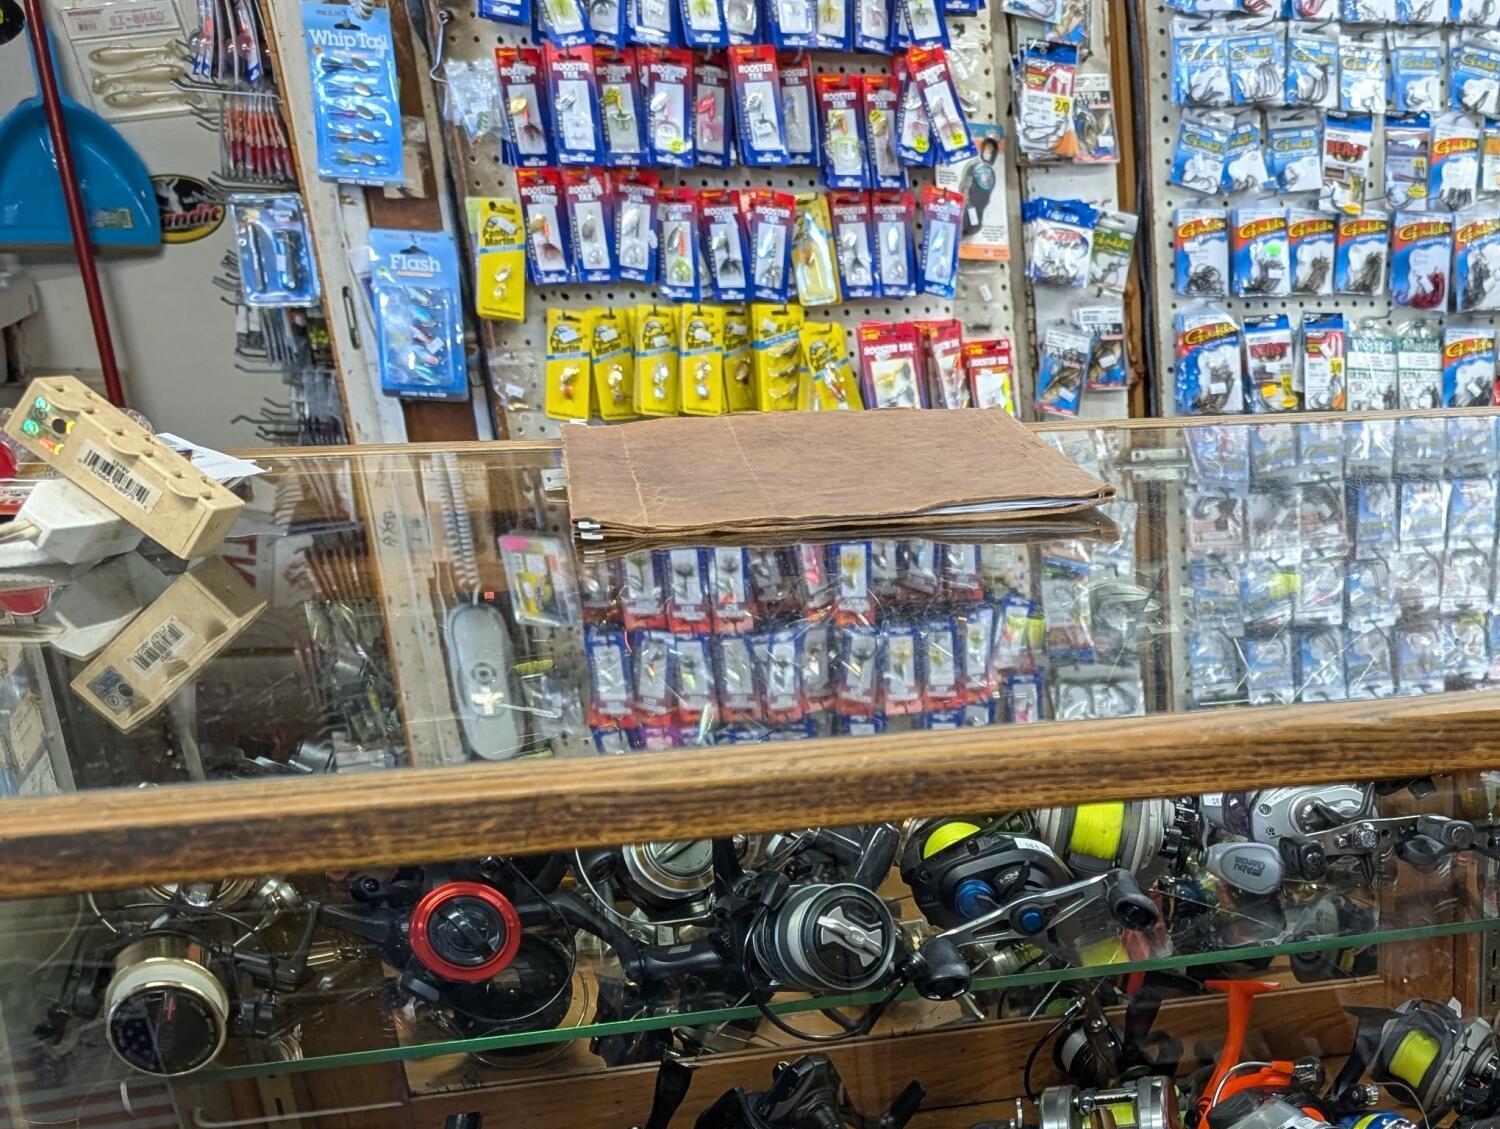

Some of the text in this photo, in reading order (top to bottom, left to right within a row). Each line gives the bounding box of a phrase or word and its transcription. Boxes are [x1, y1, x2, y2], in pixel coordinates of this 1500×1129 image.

[309, 29, 359, 53] Whip
[552, 63, 590, 74] ROOSTER
[738, 64, 773, 74] ROOSTER
[390, 254, 440, 273] Flash
